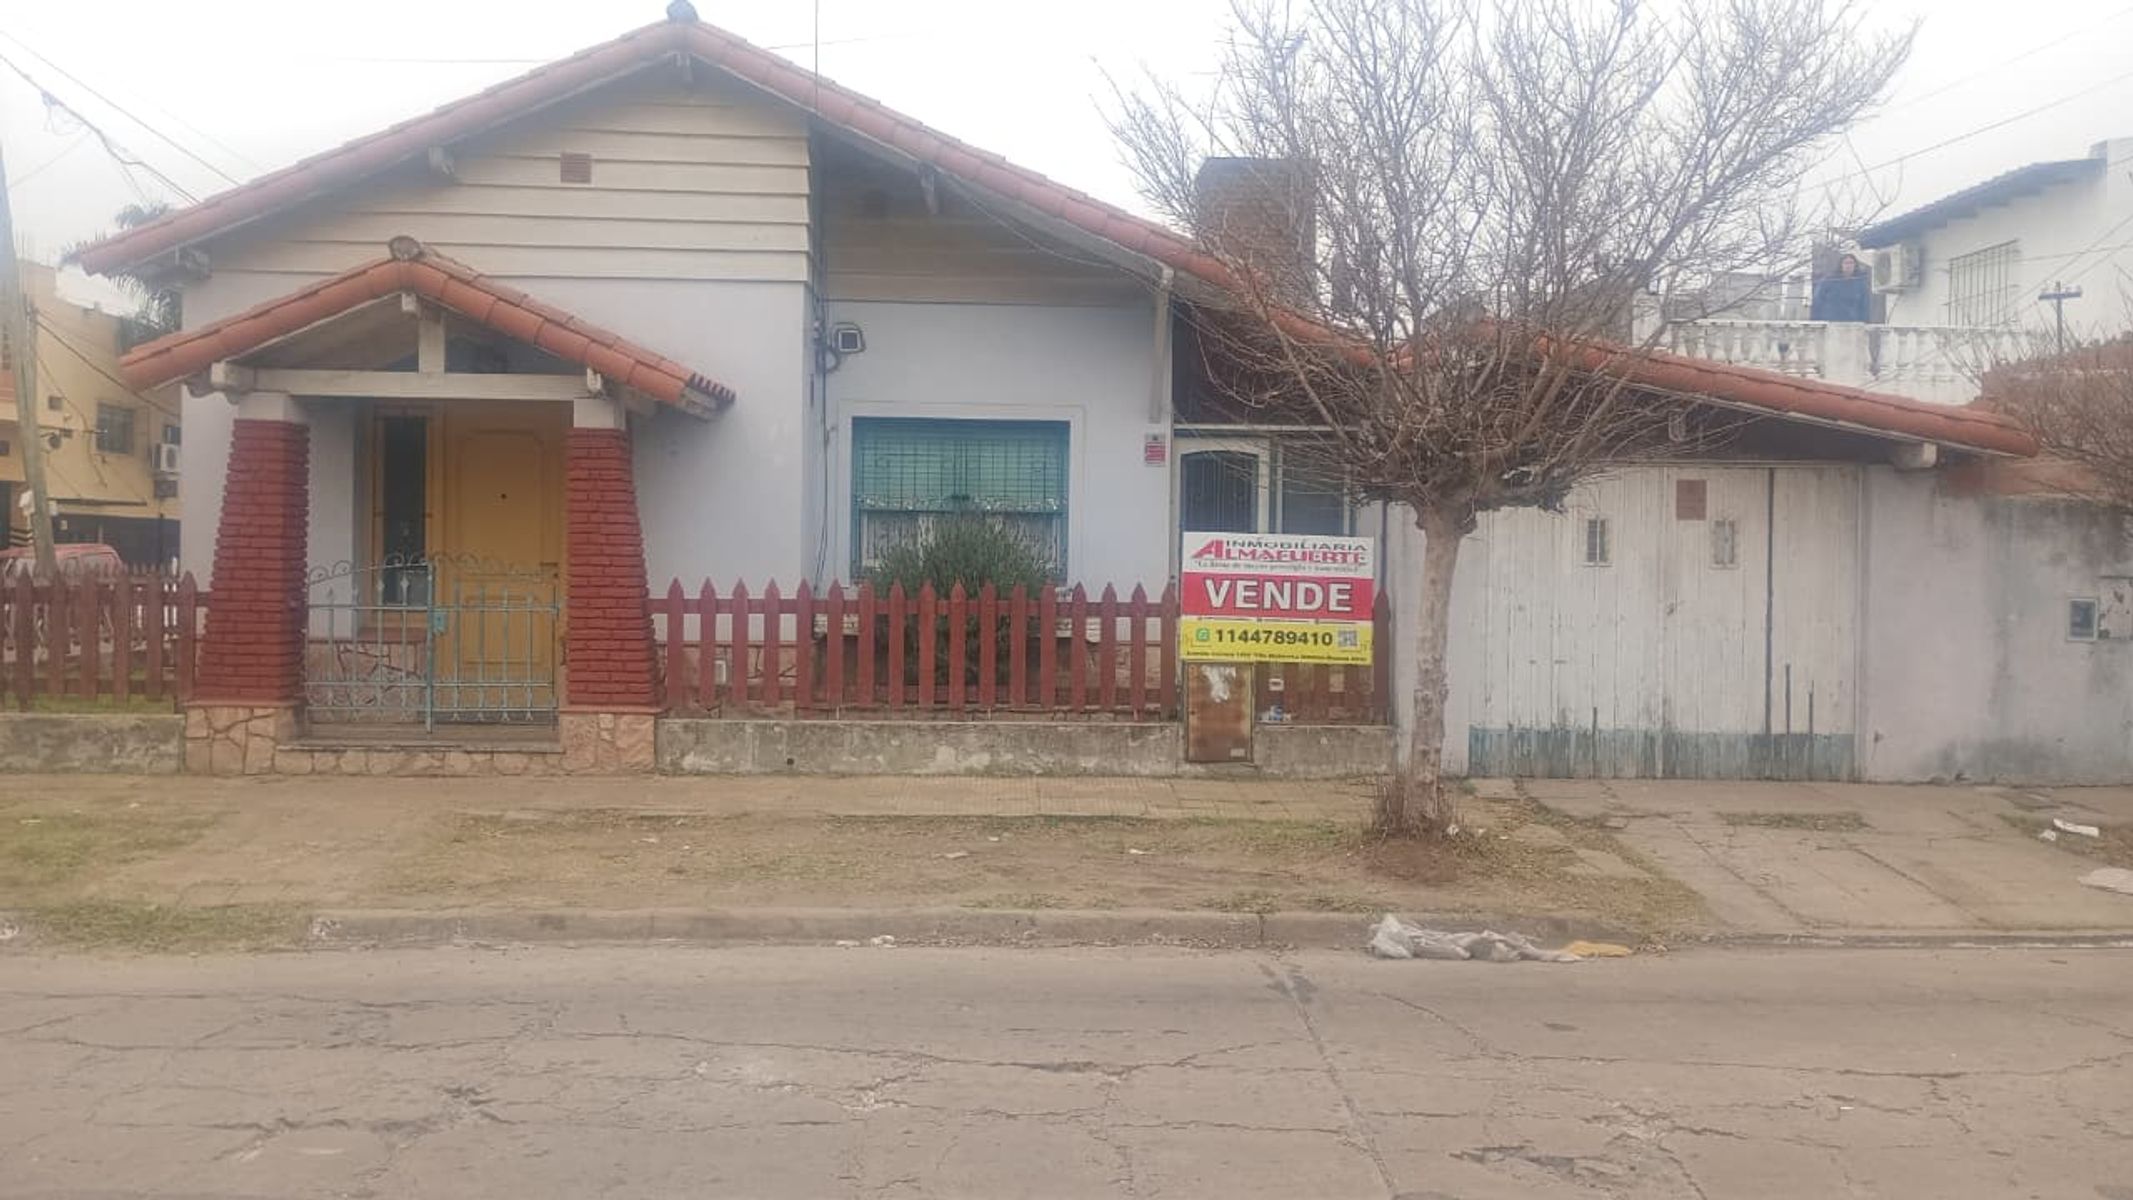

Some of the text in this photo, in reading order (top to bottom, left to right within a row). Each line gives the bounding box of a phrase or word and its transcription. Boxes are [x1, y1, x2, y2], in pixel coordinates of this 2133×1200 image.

[1192, 539, 1367, 565] ALMAFUERTE
[1226, 540, 1367, 551] INMOBILIARIA
[1205, 578, 1353, 612] VENDE
[1216, 629, 1333, 646] 1144789410
